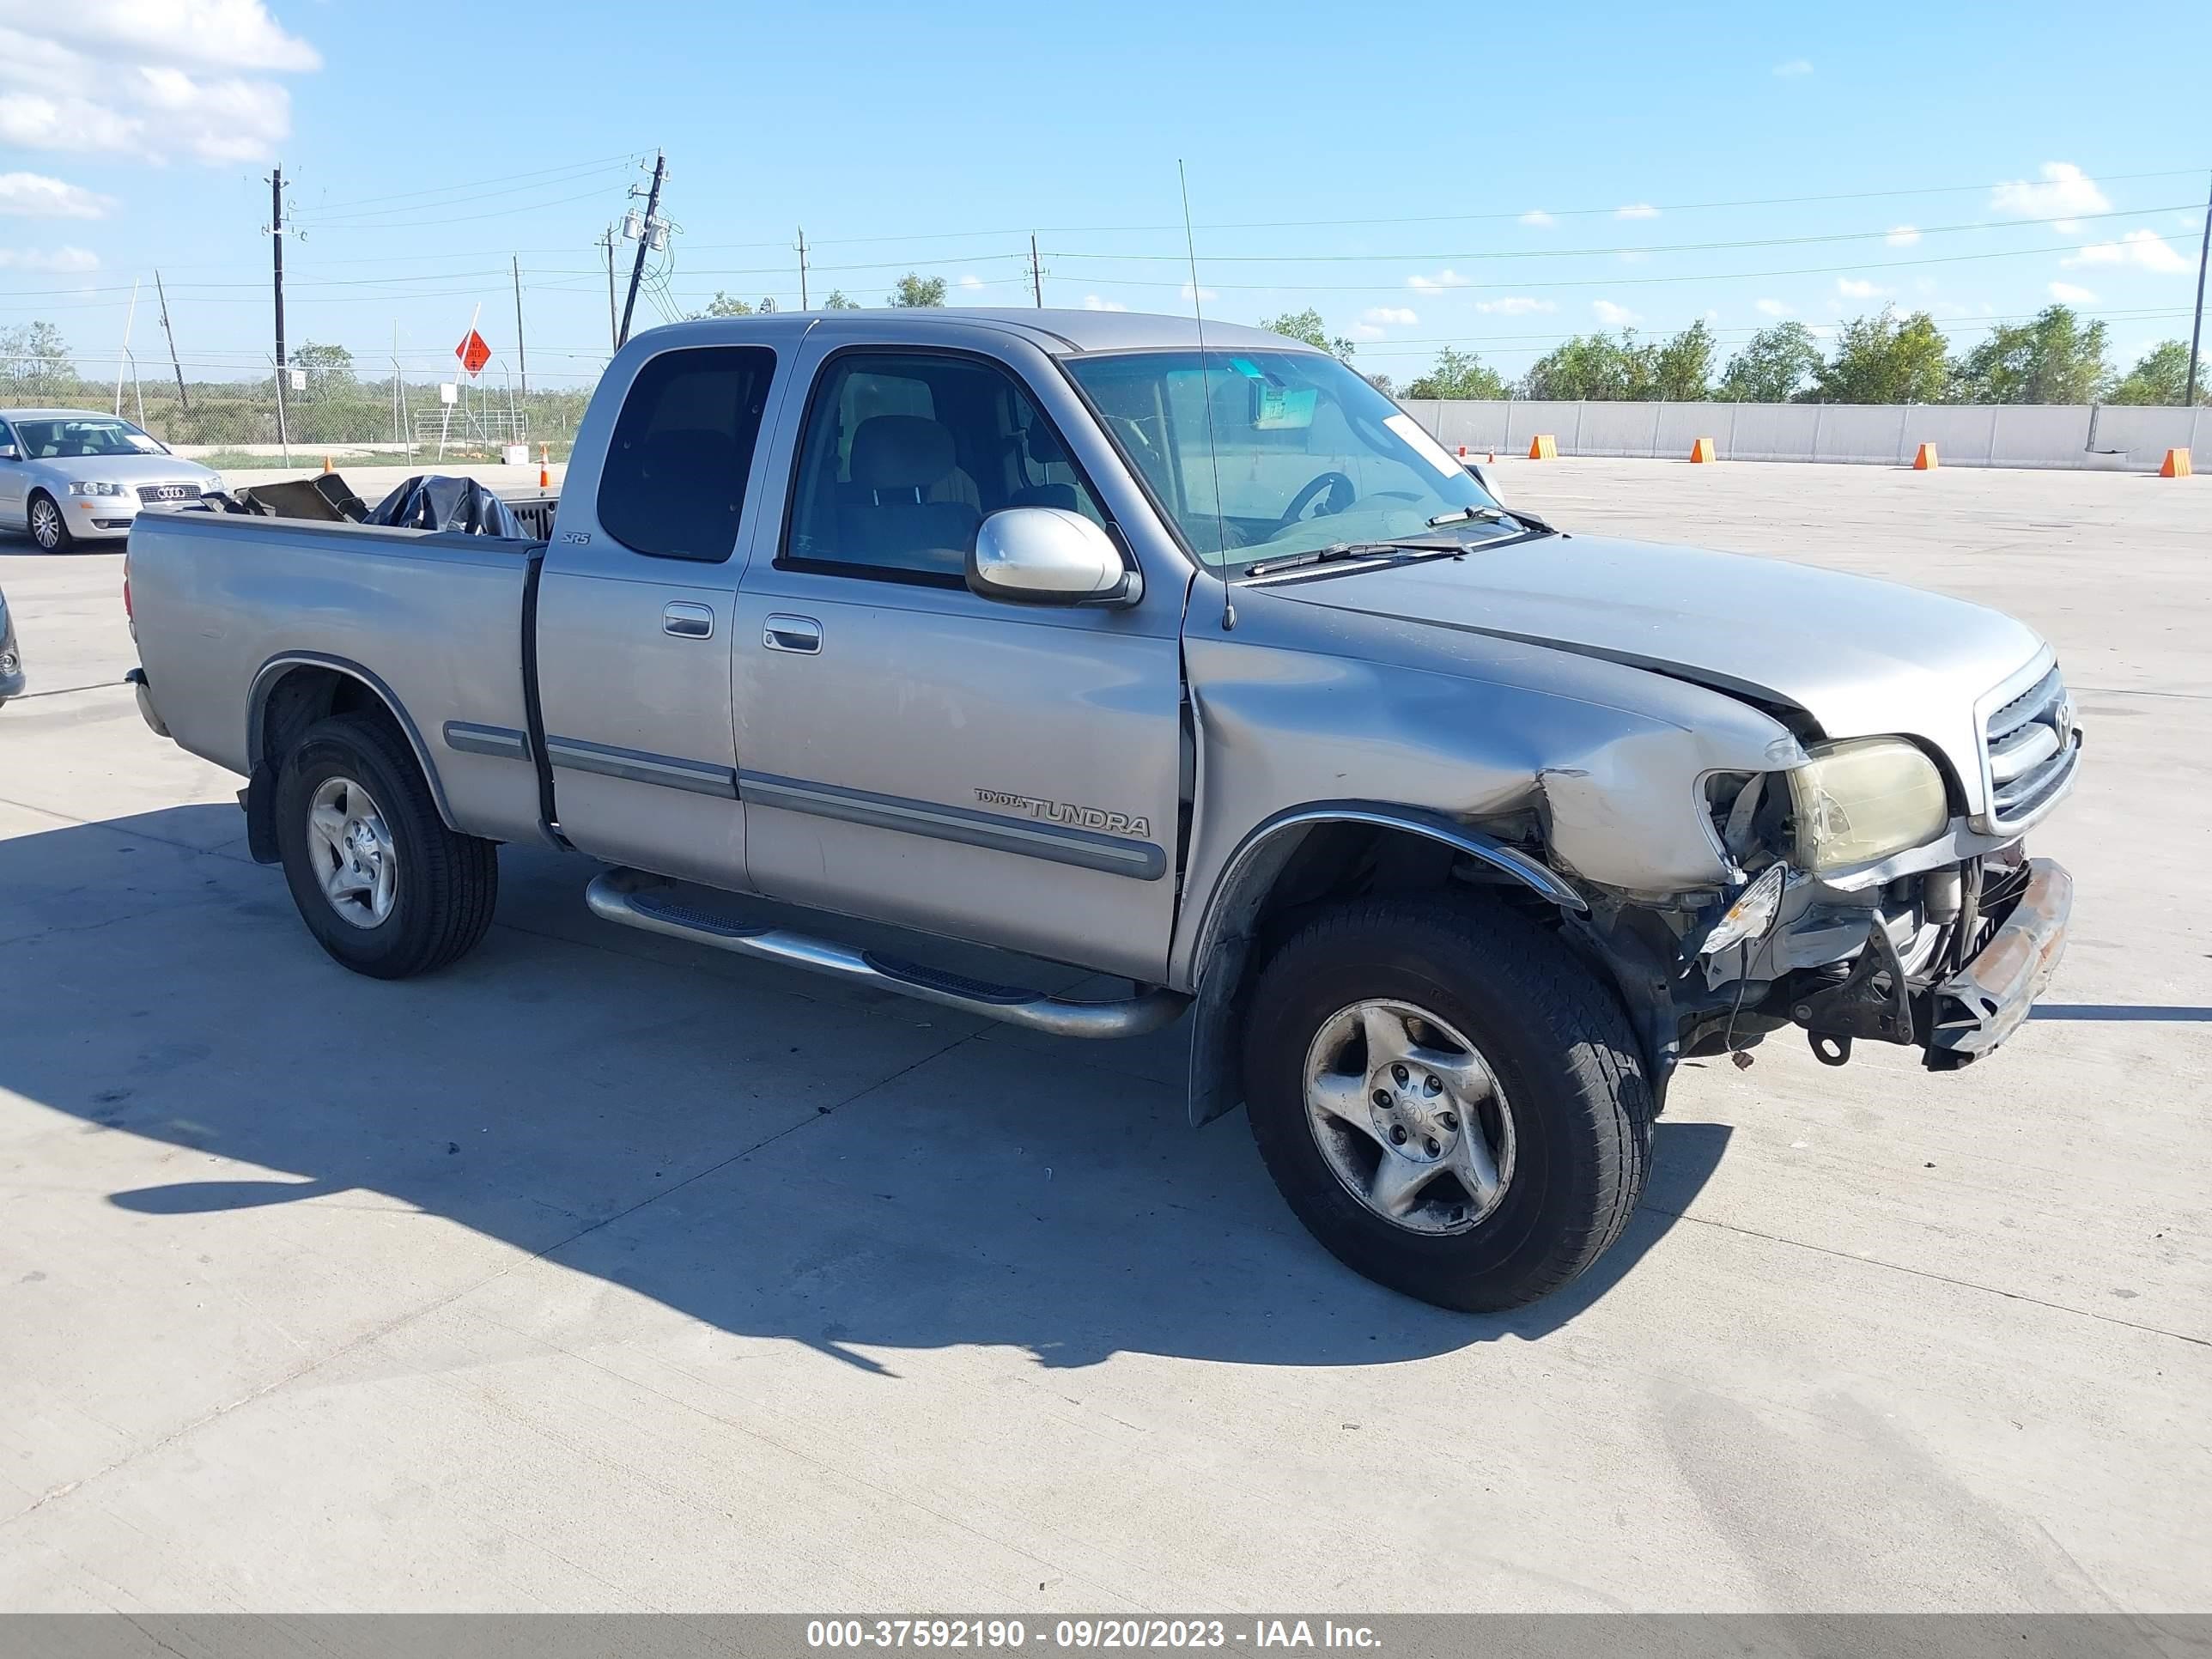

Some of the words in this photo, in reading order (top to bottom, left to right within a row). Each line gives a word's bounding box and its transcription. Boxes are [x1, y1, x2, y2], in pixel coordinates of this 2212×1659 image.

[561, 532, 591, 544] SR5
[974, 787, 1026, 809] TOYOTA
[1024, 797, 1150, 837] TUNDRA
